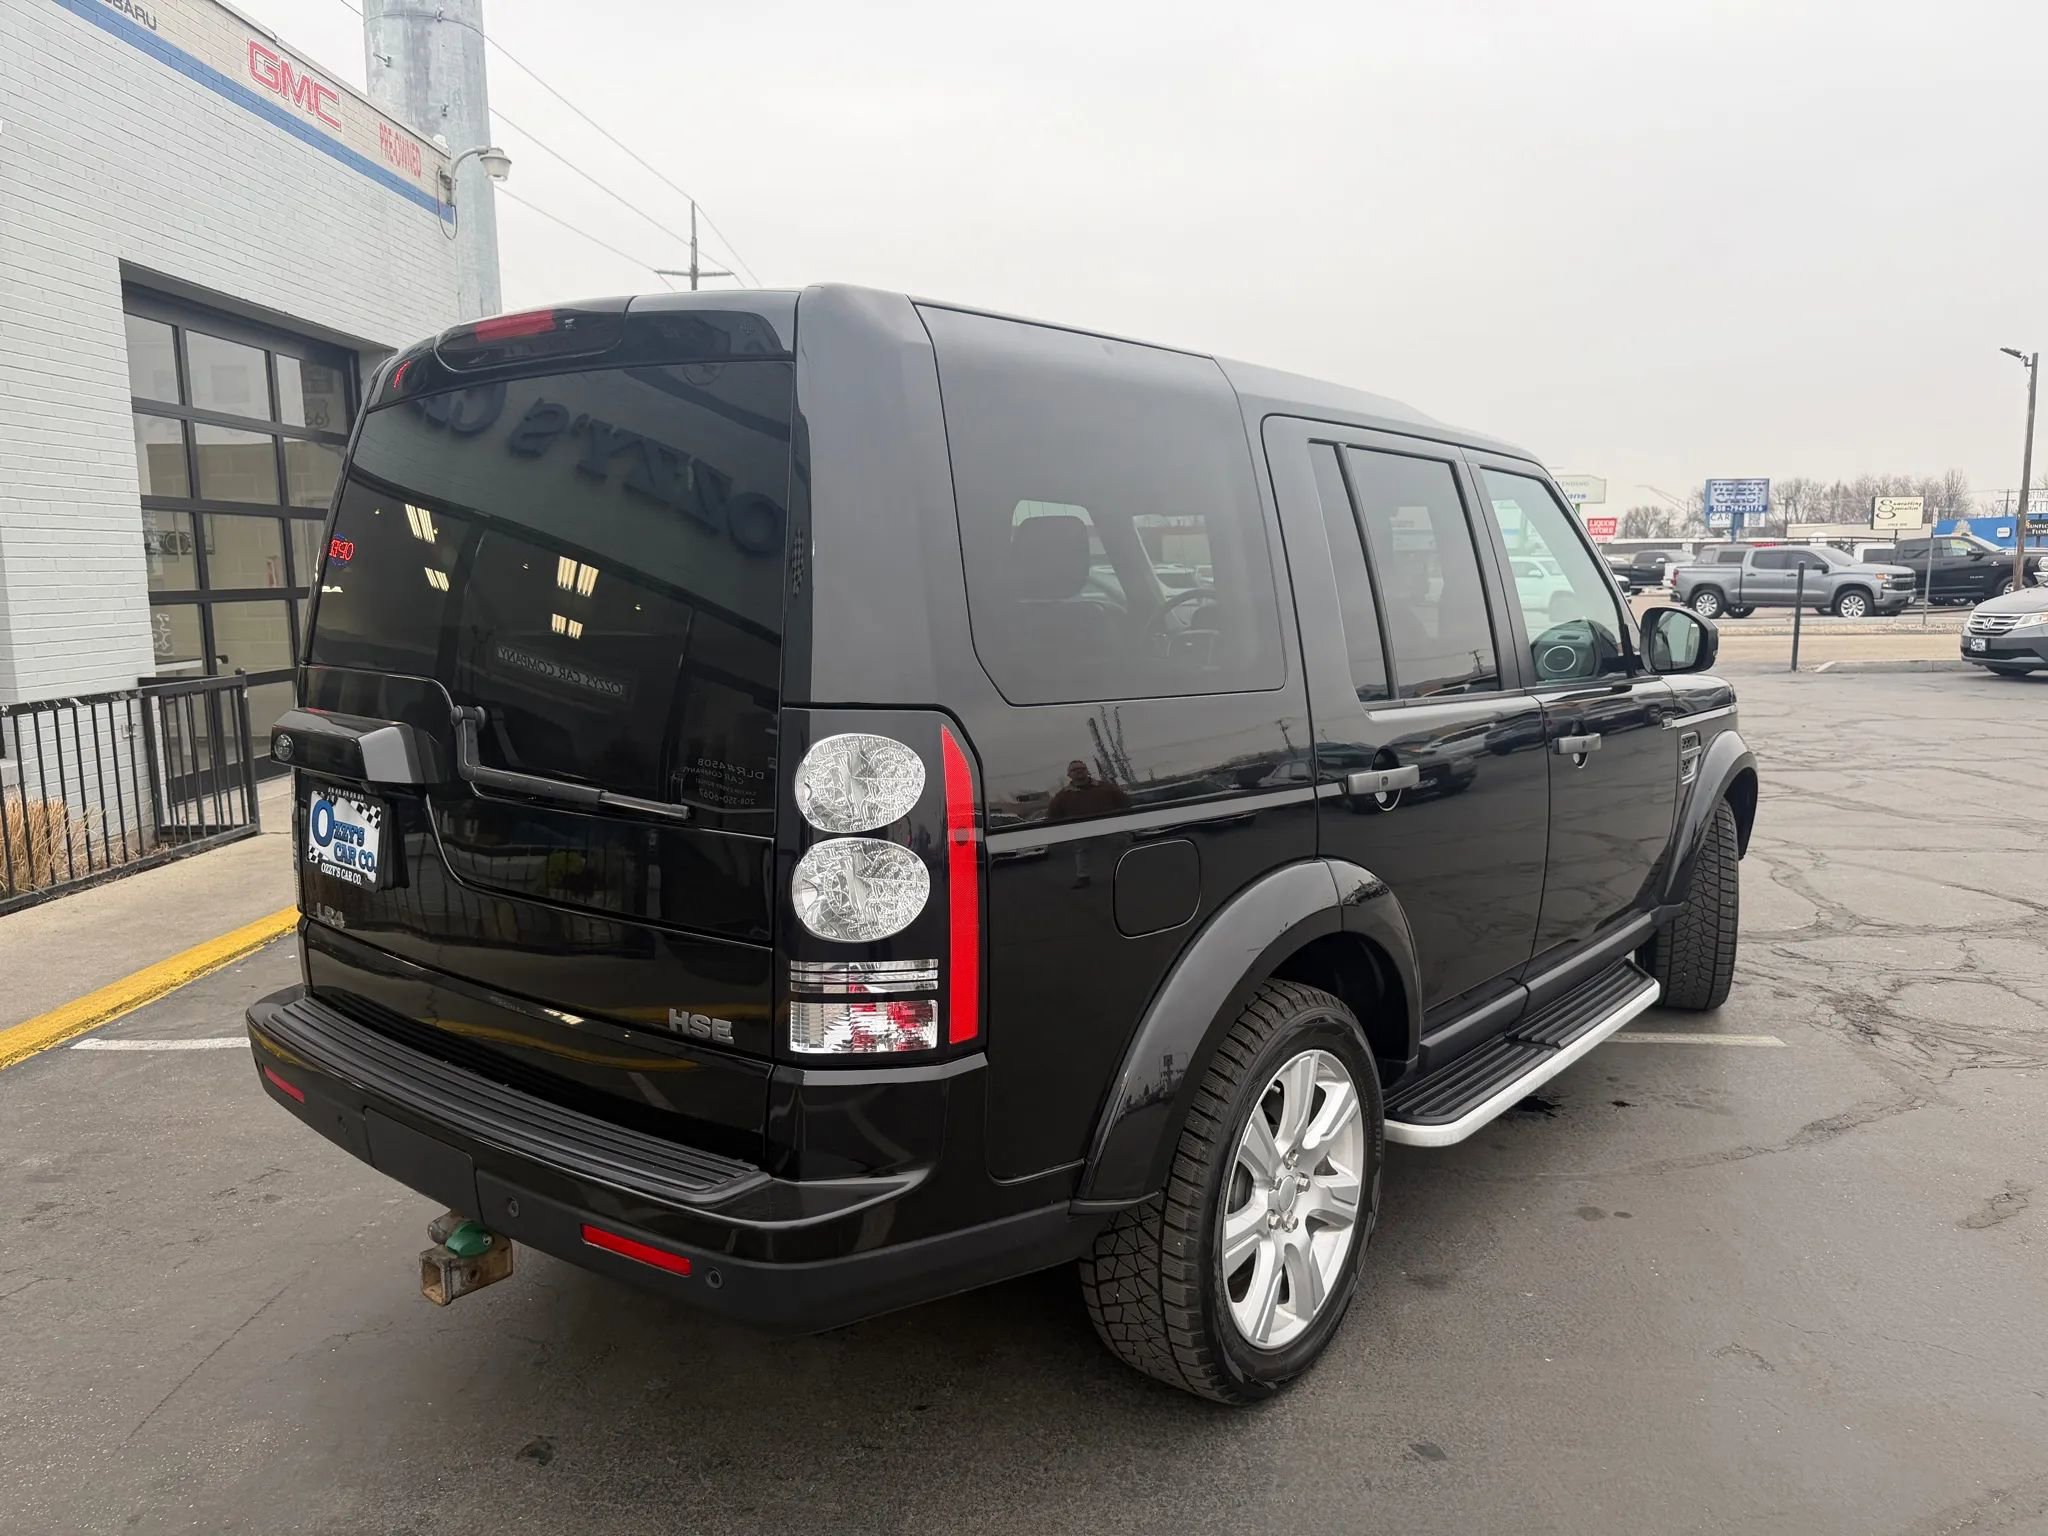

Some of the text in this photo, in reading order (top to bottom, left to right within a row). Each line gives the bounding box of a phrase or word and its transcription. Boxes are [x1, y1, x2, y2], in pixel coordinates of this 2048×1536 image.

[105, 0, 157, 31] BARU
[247, 37, 342, 132] GMC
[1710, 513, 1730, 521] CAR
[312, 799, 365, 847] OZZY'S
[333, 841, 357, 867] CAR
[320, 862, 362, 885] OZZY'S CAR CO.
[316, 902, 345, 929] LR4
[668, 1008, 735, 1045] HSE
